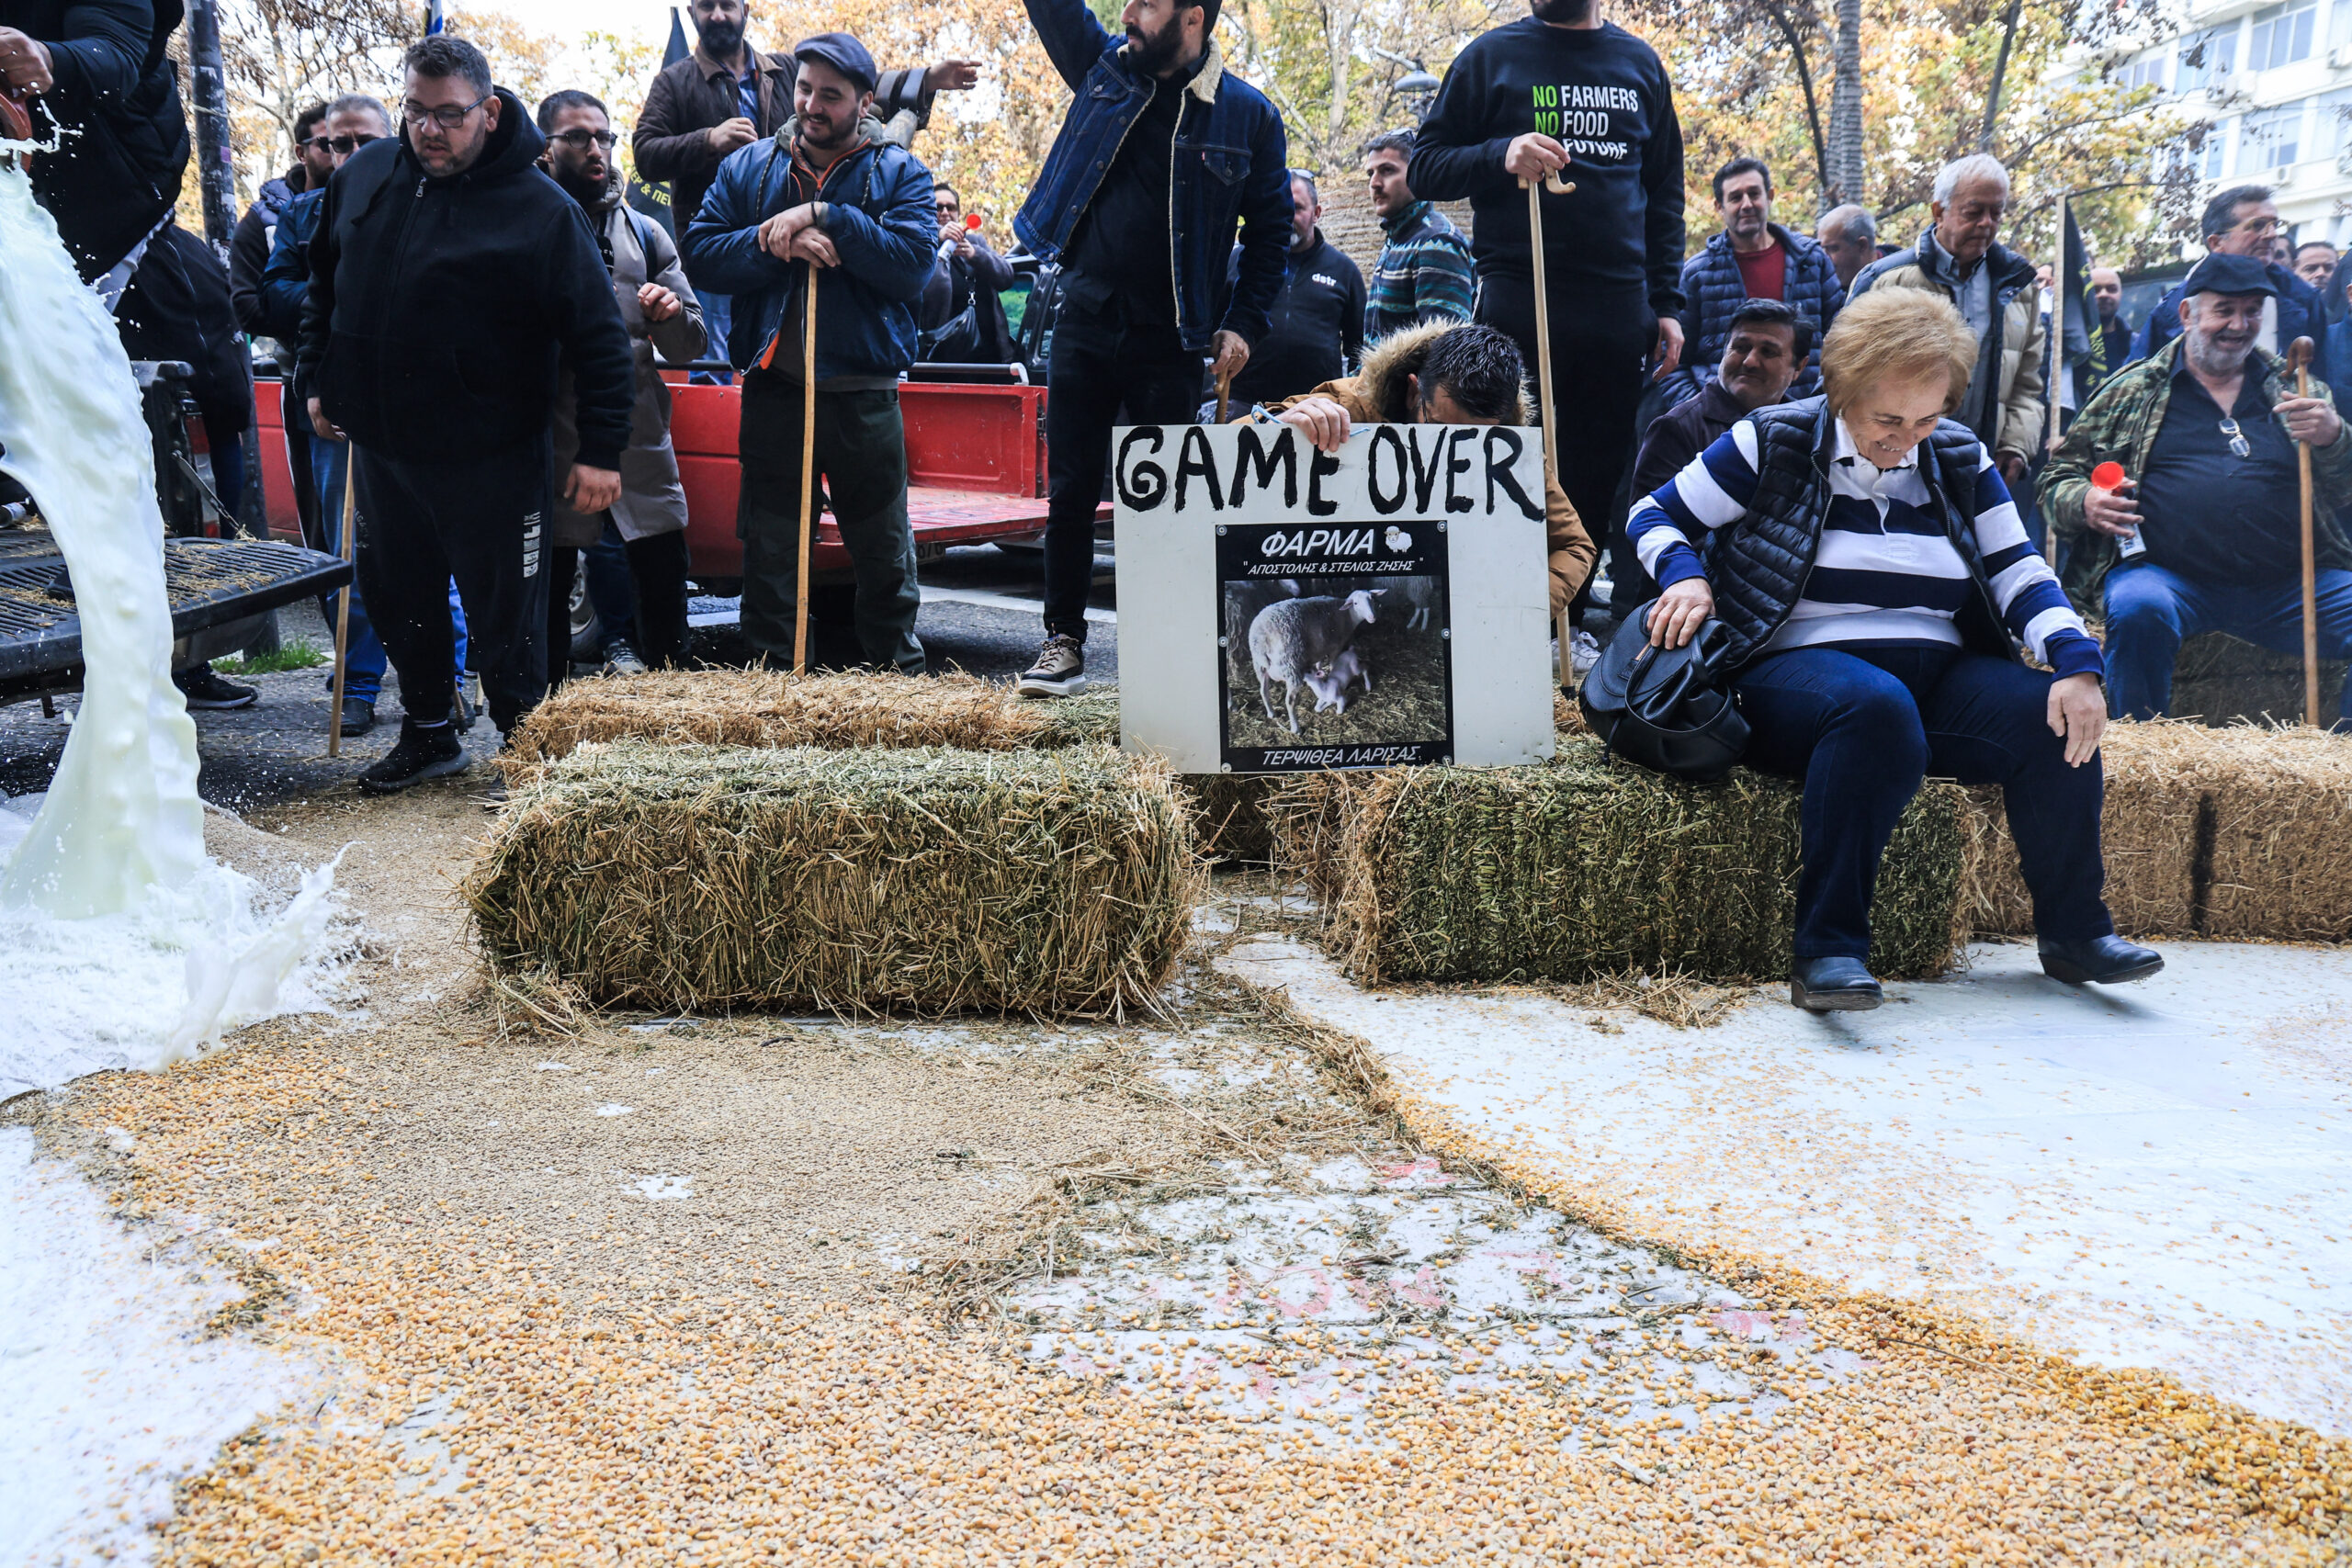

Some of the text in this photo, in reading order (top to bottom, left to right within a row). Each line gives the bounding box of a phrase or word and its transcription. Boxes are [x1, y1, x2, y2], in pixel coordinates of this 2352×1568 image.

[1532, 85, 1639, 112] NO FARMERS
[1534, 110, 1609, 136] NO FOOD
[1312, 273, 1337, 287] dstr
[1115, 424, 1546, 523] GAME OVER
[1261, 528, 1374, 558] ΦΑΡΜΑ
[1319, 563, 1328, 573] &
[1329, 561, 1376, 573] ΣΤΕΛΙΟΣ
[1262, 746, 1421, 765] ΤΕΡΨΙΘΕΑ ΛΑΡΙΣΑΣ
